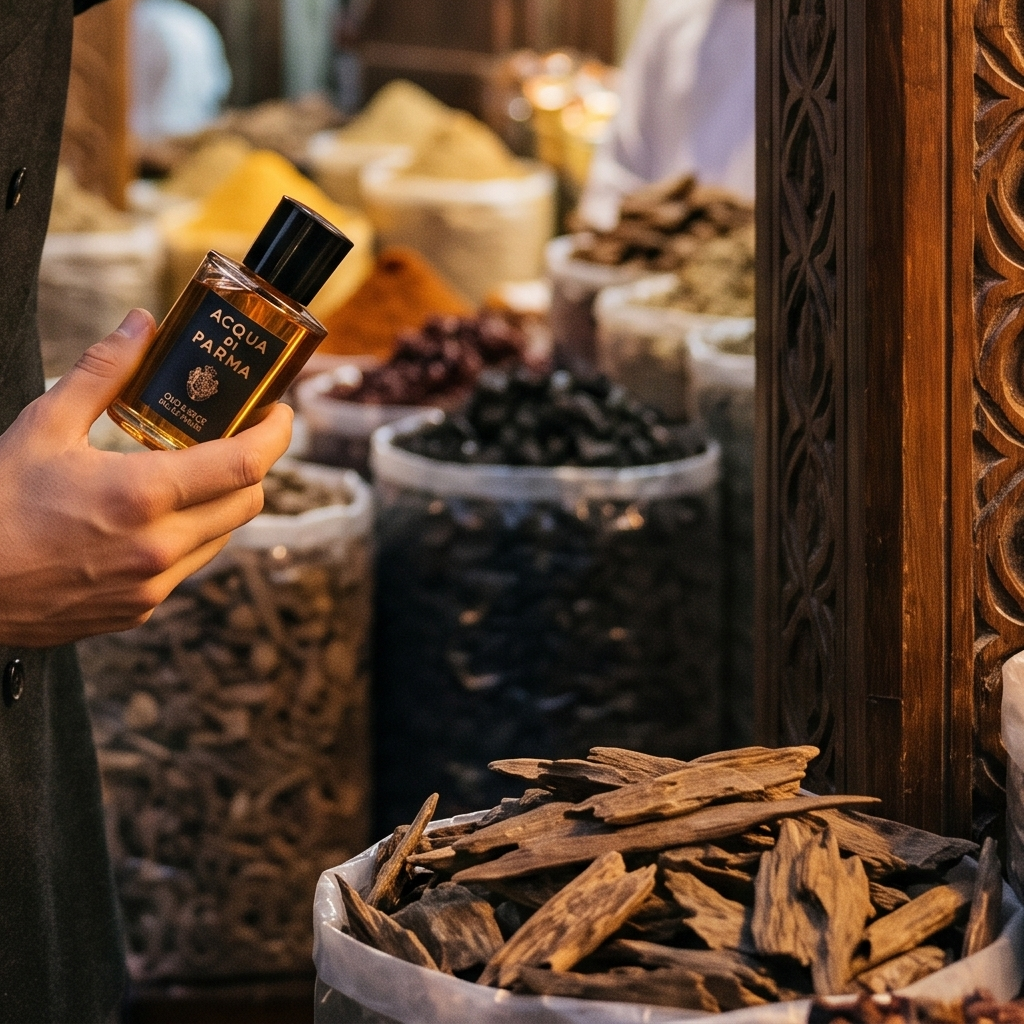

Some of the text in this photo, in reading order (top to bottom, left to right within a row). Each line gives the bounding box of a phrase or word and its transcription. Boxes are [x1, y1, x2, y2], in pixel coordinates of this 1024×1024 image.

[192, 330, 250, 380] PARMA
[210, 309, 267, 355] ACQUA
[223, 336, 238, 351] DI
